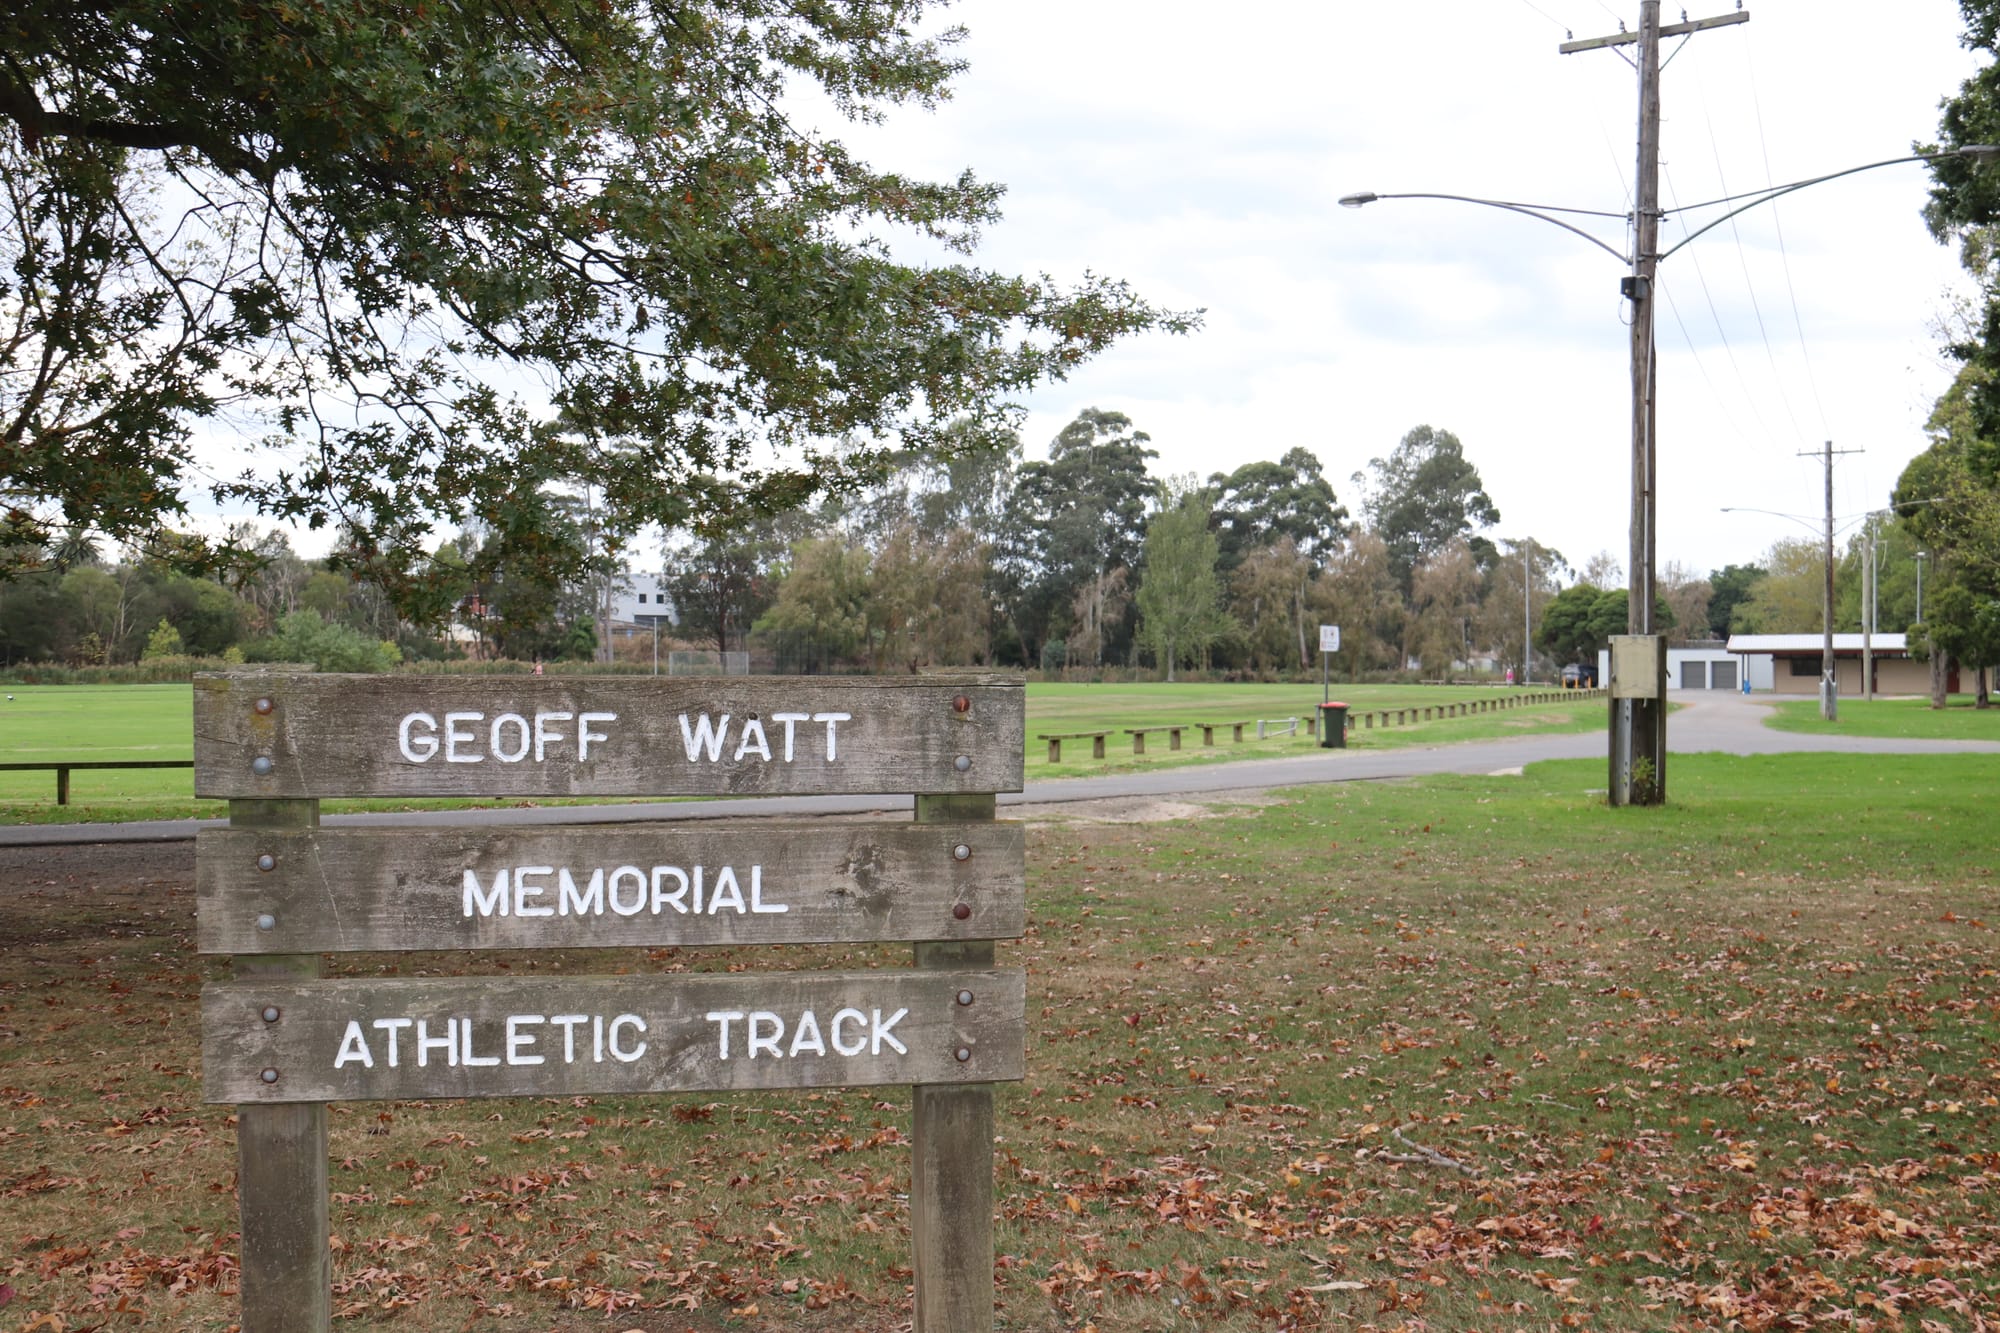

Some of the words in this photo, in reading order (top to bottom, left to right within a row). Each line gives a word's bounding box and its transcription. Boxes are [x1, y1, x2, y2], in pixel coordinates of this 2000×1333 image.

[398, 712, 617, 763] GEOFF
[679, 712, 852, 762] WATT
[462, 865, 789, 918] MEMORIAL
[335, 1013, 647, 1069] ATHLETIC
[706, 1007, 909, 1060] TRACK
